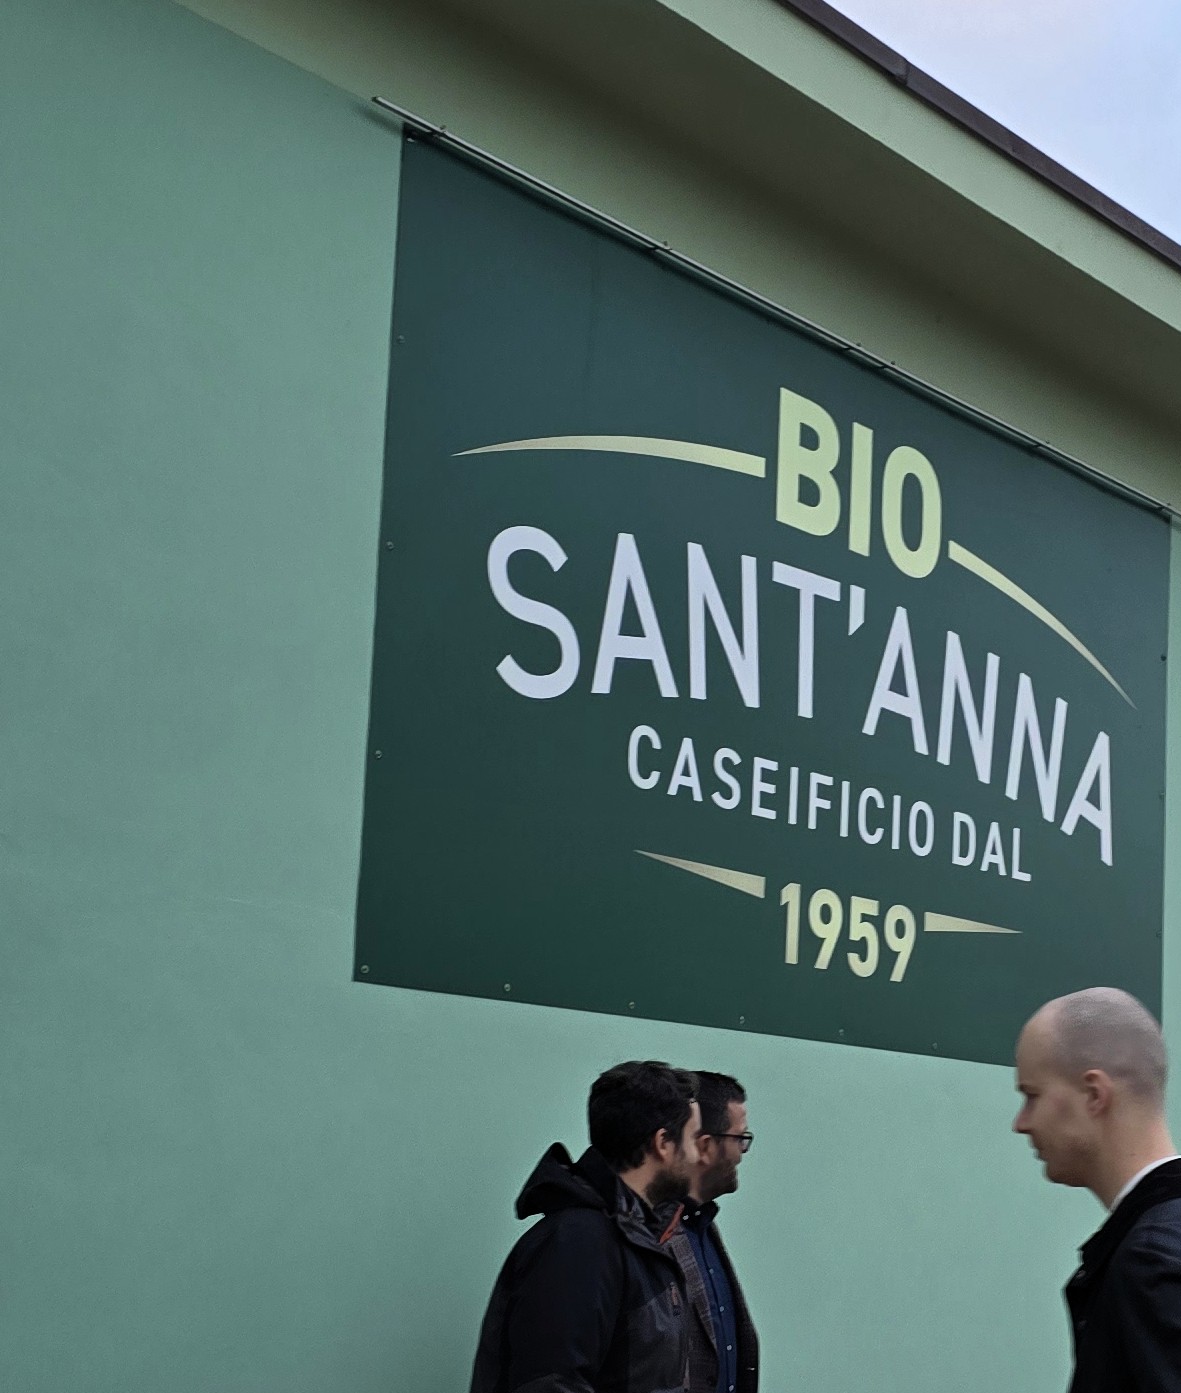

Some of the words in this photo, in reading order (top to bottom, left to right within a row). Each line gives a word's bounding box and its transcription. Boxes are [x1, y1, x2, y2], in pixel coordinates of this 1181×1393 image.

[775, 387, 942, 579] BIO
[487, 525, 1113, 867] SANT'ANNA
[627, 724, 935, 857] CASEIFICIO
[951, 811, 1032, 882] DAL
[779, 882, 917, 983] 1959
